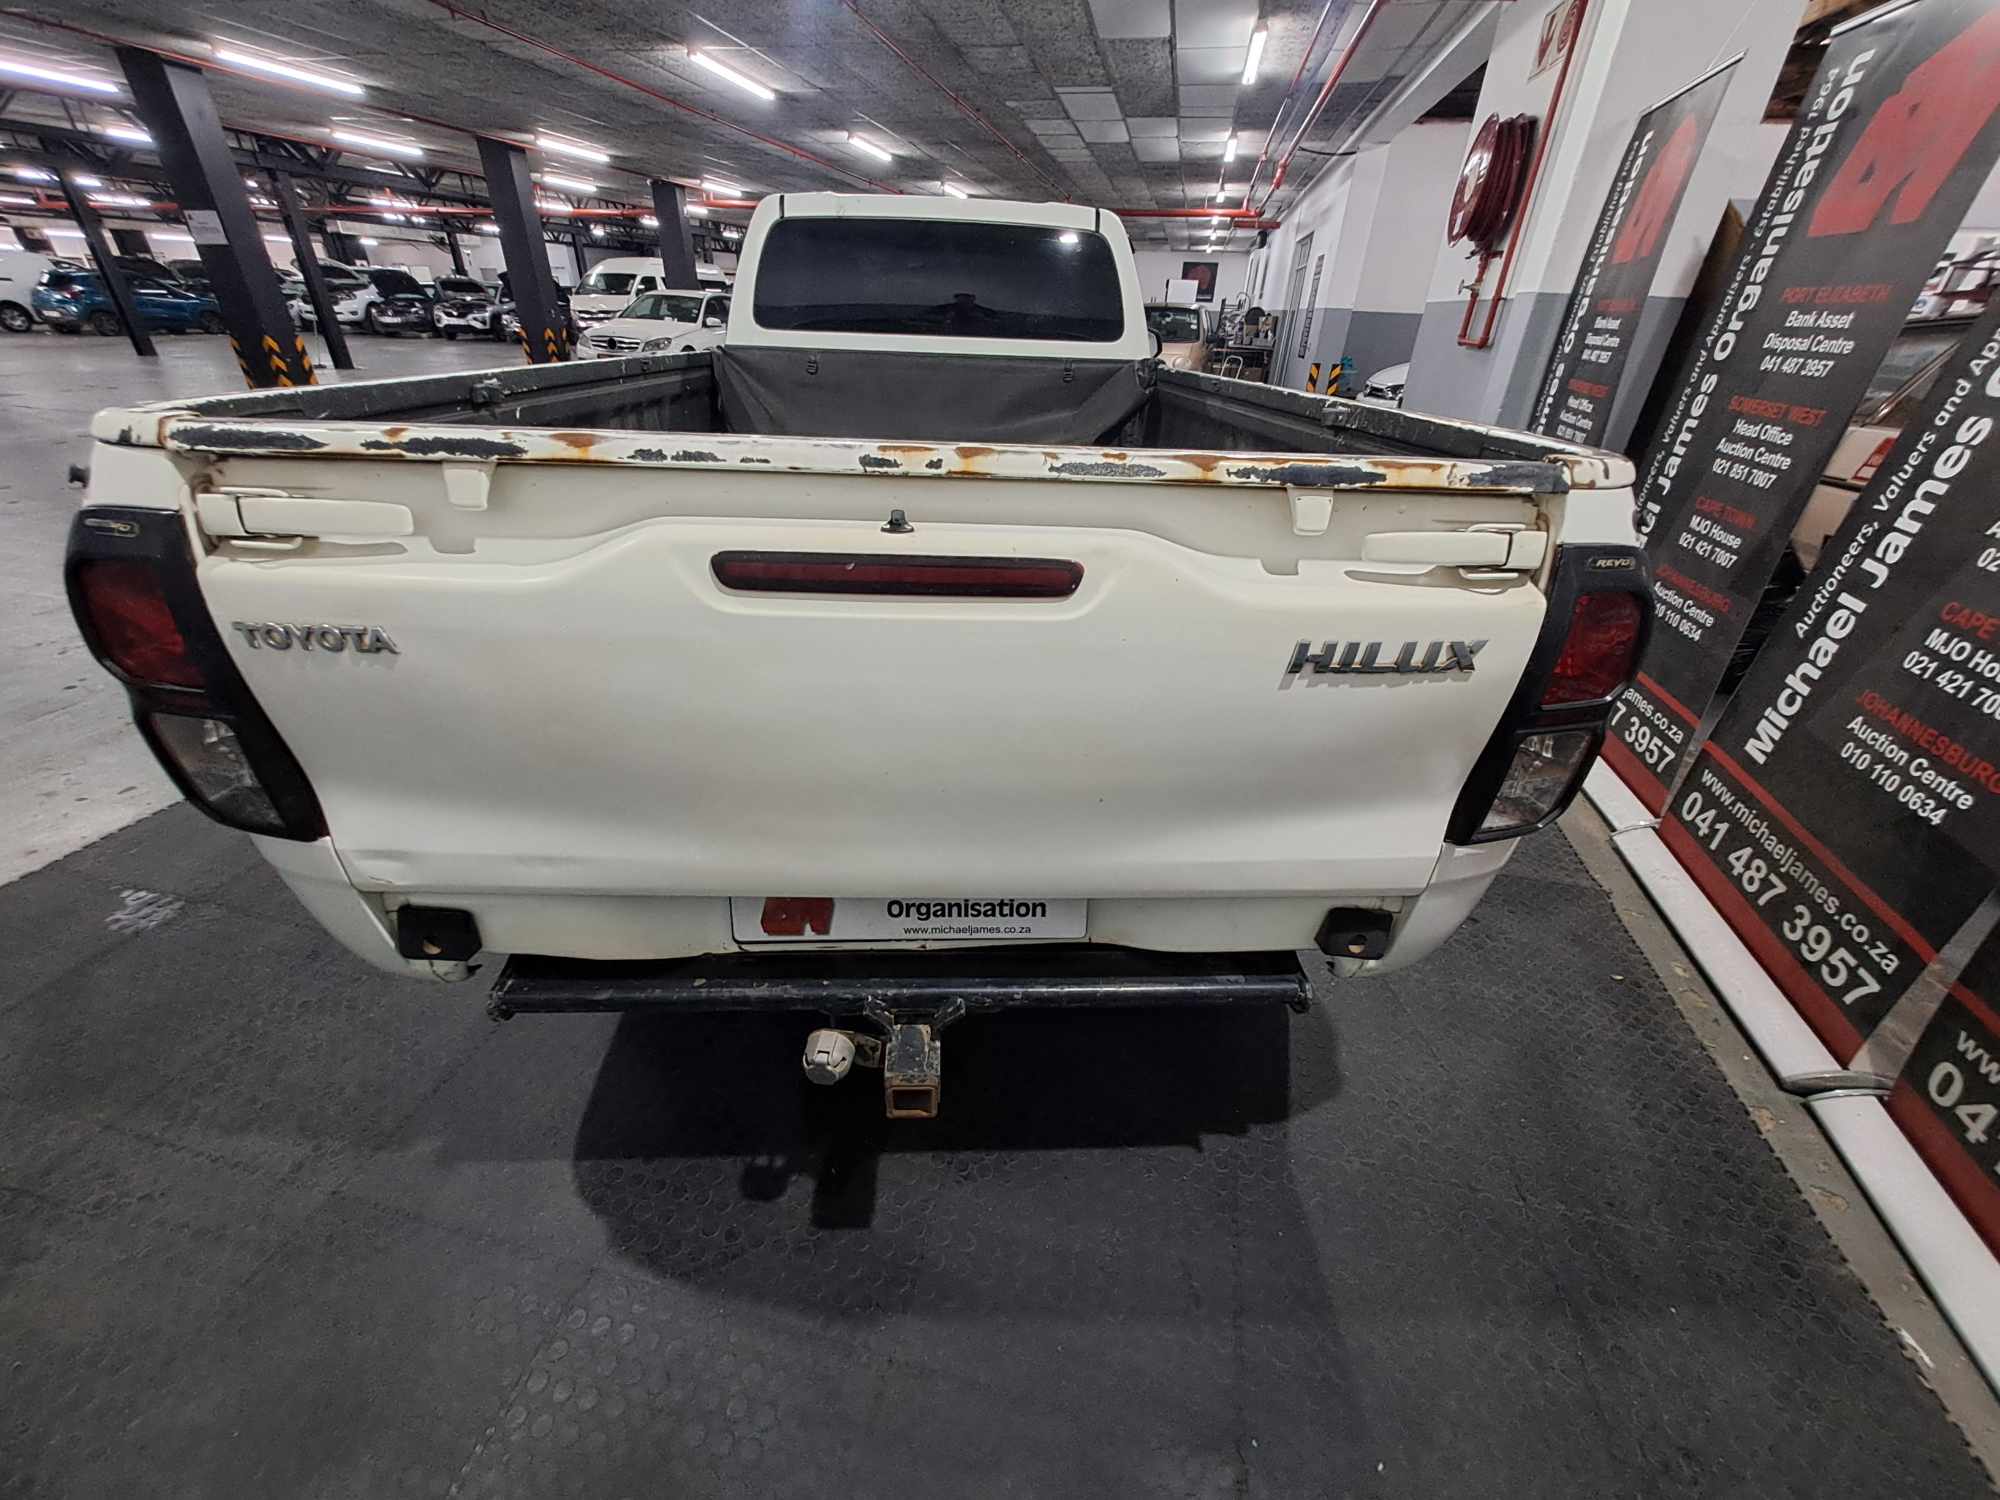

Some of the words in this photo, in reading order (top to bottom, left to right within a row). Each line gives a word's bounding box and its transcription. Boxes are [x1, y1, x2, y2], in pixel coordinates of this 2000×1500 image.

[1713, 48, 1876, 361] Organisation
[1689, 349, 1708, 383] and
[1754, 127, 1812, 237] Established
[1807, 67, 1840, 120] 1964
[1785, 310, 1818, 328] Bank
[1815, 311, 1856, 328] Asset
[1762, 332, 1815, 353] Disposal
[1811, 335, 1855, 354] Centre
[1760, 355, 1783, 372] 041
[1781, 357, 1805, 374] 487
[1800, 359, 1835, 378] 3957
[1656, 373, 1719, 496] James
[1733, 418, 1762, 437] Head
[1760, 425, 1793, 445] Office
[1716, 437, 1755, 460] Auction
[1754, 447, 1792, 470] Centre
[1712, 458, 1733, 475] 021
[1729, 463, 1750, 481] 851
[1747, 469, 1778, 489] 7007
[1794, 521, 1880, 639] Auctioneers,
[1872, 431, 1937, 512] Valuers
[1934, 378, 1972, 427] and
[1708, 523, 1742, 549] House
[1711, 547, 1738, 569] 7007
[1744, 591, 1868, 765] Michael
[1860, 416, 1994, 590] James
[1664, 609, 1682, 628] 110
[1683, 599, 1714, 628] Centre
[1940, 601, 2000, 640] CAPE
[232, 621, 401, 654] TOYOTA
[1924, 627, 1973, 661] MJO
[1287, 638, 1491, 674] HILUX
[1903, 650, 1940, 680] 021
[1936, 670, 1975, 699] 421
[1624, 716, 1676, 773] 3957
[1846, 716, 1910, 767] Auction
[1908, 757, 1974, 811] Centre
[1840, 742, 1872, 771] 010
[1870, 763, 1902, 792] 110
[1898, 785, 1948, 826] 0634
[1701, 768, 1900, 975] www.michaeljames.co.za
[886, 898, 1047, 922] Organisation
[1681, 791, 1730, 851] 041
[1728, 846, 1788, 906] 487
[1782, 904, 1882, 1005] 3957
[903, 924, 1032, 936] www.michaeljames.co.za
[1928, 1061, 2000, 1160] 04
